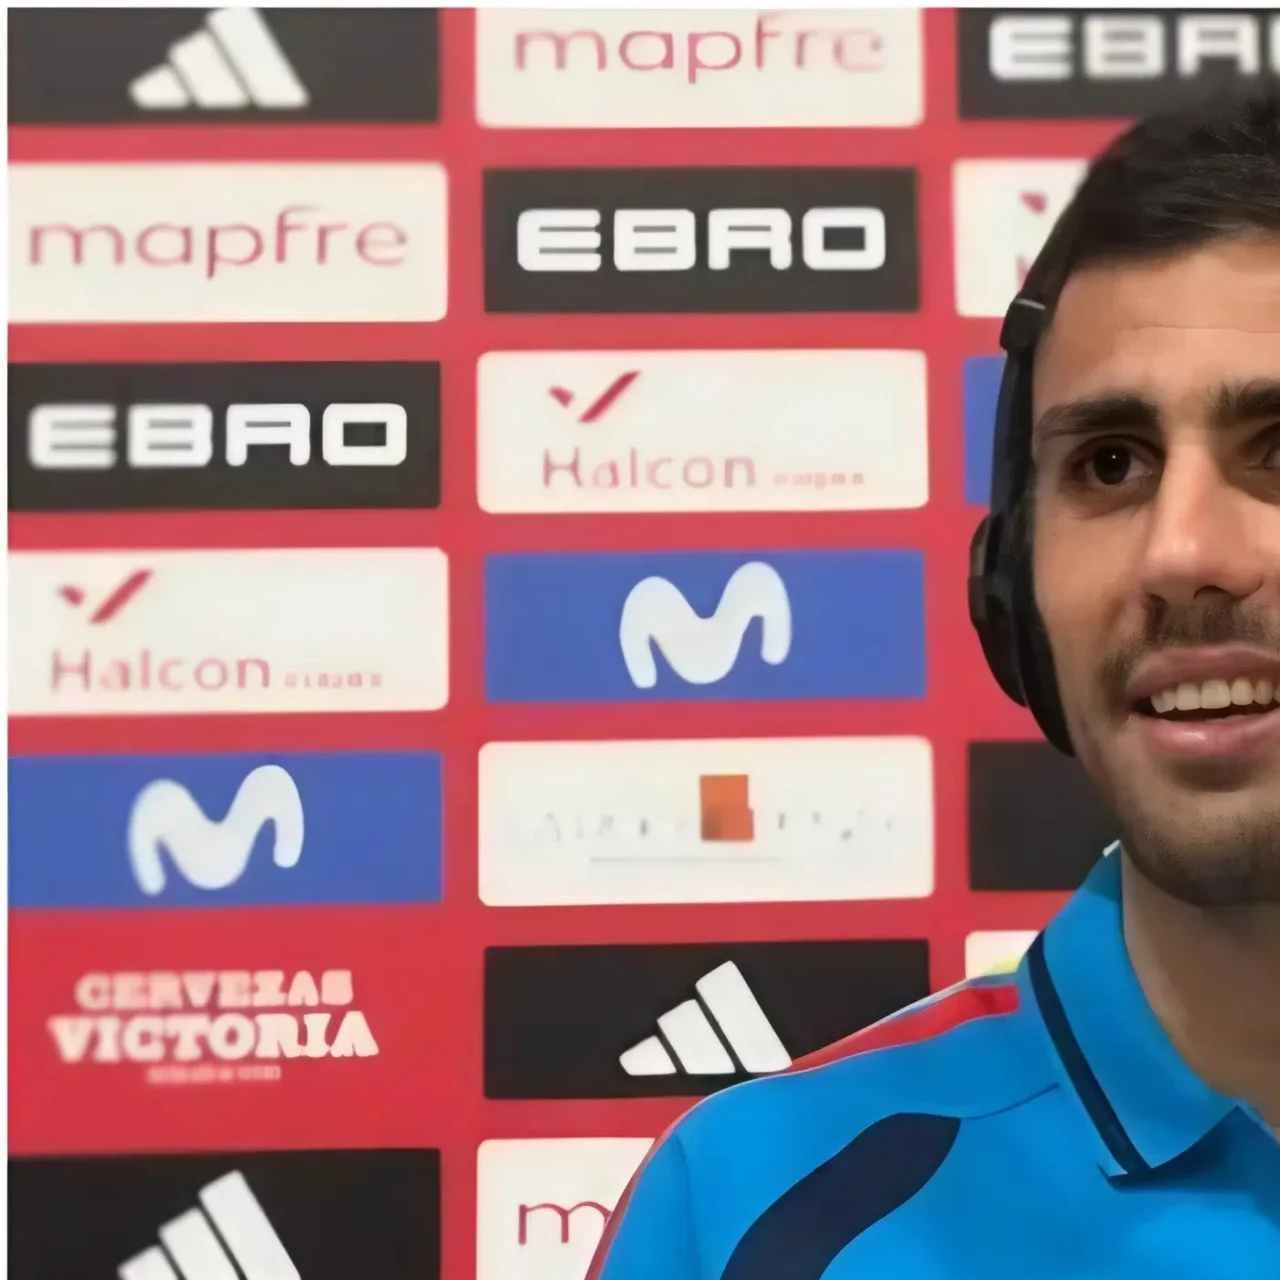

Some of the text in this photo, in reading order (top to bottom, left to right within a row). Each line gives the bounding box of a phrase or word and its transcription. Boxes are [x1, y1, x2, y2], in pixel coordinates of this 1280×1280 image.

[514, 13, 886, 84] mapfre
[28, 204, 409, 280] mapfre
[517, 207, 886, 272] EBRO
[28, 402, 408, 469] EBRO
[47, 1011, 380, 1064] VICTORIA
